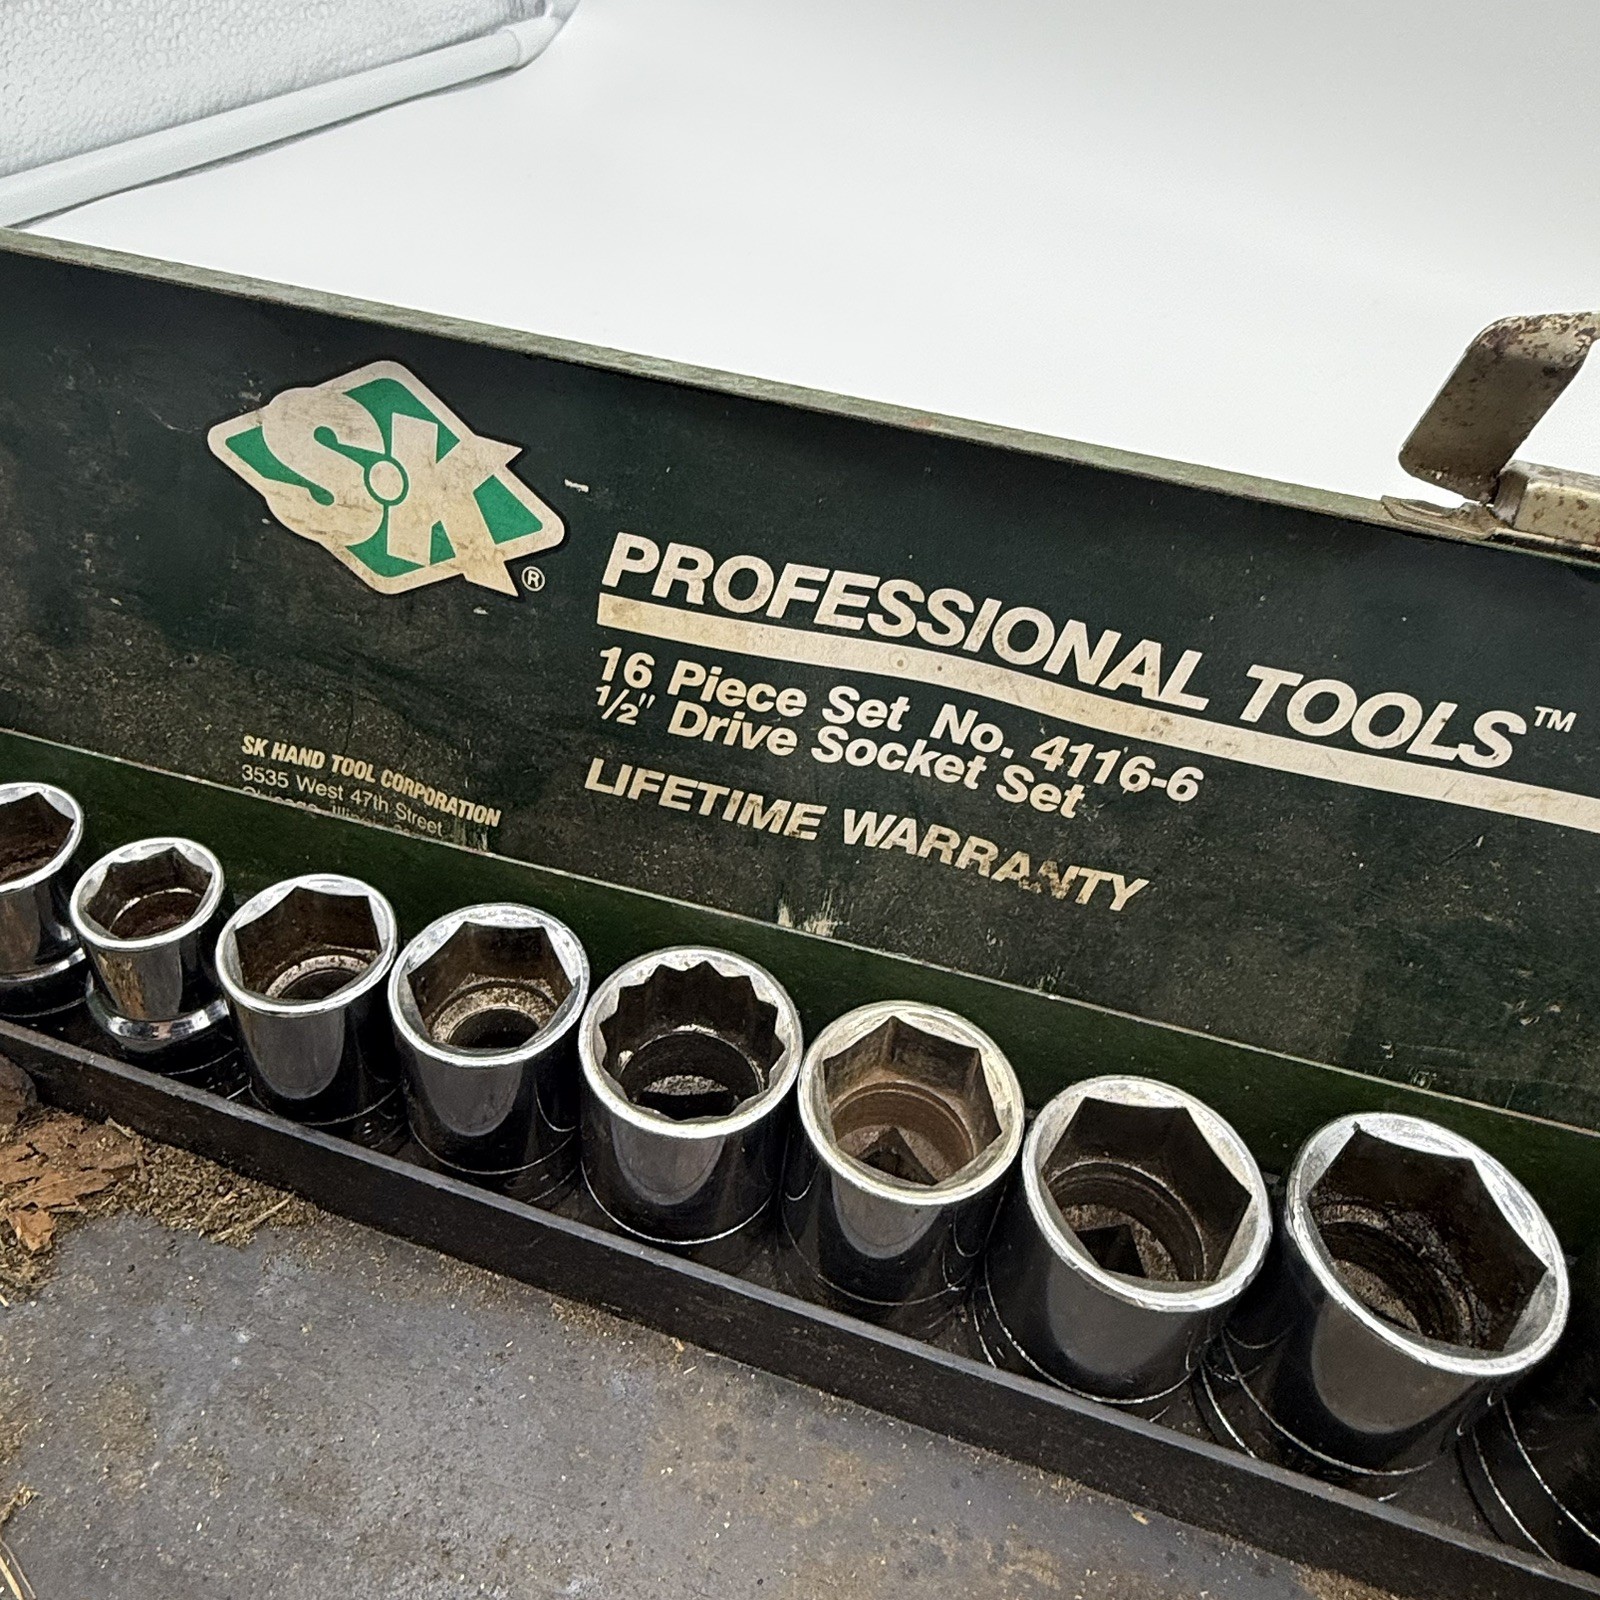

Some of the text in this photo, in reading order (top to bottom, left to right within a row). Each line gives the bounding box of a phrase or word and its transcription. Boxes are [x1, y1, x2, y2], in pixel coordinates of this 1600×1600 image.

[262, 386, 524, 597] SK
[599, 646, 1204, 804] 16 Piece Set No. 4116-6
[602, 531, 1209, 711] PROFESSIONAL
[1239, 664, 1527, 769] TOOLS
[241, 735, 267, 758] SK
[271, 741, 325, 770] HAND
[331, 754, 376, 784] TOOL
[381, 769, 502, 827] CORPORATION
[241, 764, 289, 788] 3535
[296, 774, 344, 801] West
[350, 788, 390, 814] 47th
[395, 801, 443, 838] Street
[584, 757, 1150, 912] LIFETIME WARRANTY
[667, 700, 798, 756] Drive
[811, 725, 988, 790] Socket
[995, 764, 1086, 819] Set
